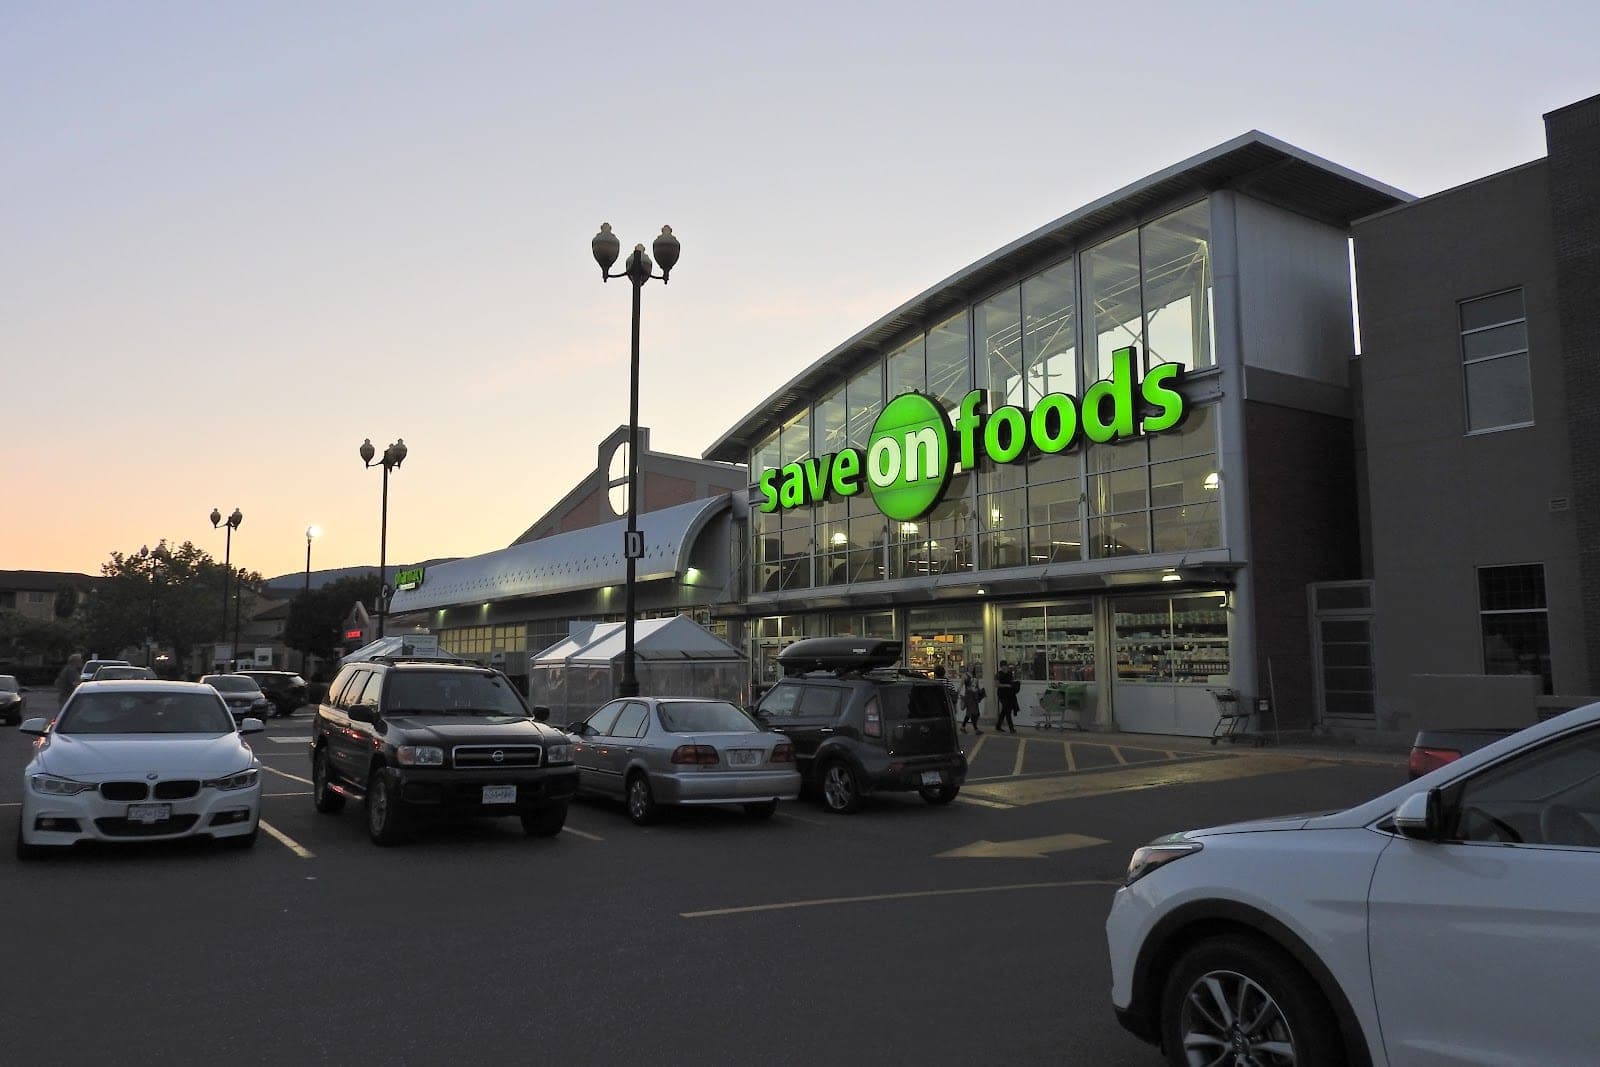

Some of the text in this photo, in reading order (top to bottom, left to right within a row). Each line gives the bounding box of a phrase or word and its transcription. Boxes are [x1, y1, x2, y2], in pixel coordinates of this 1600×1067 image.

[758, 347, 1184, 513] save on foods
[627, 532, 641, 558] D
